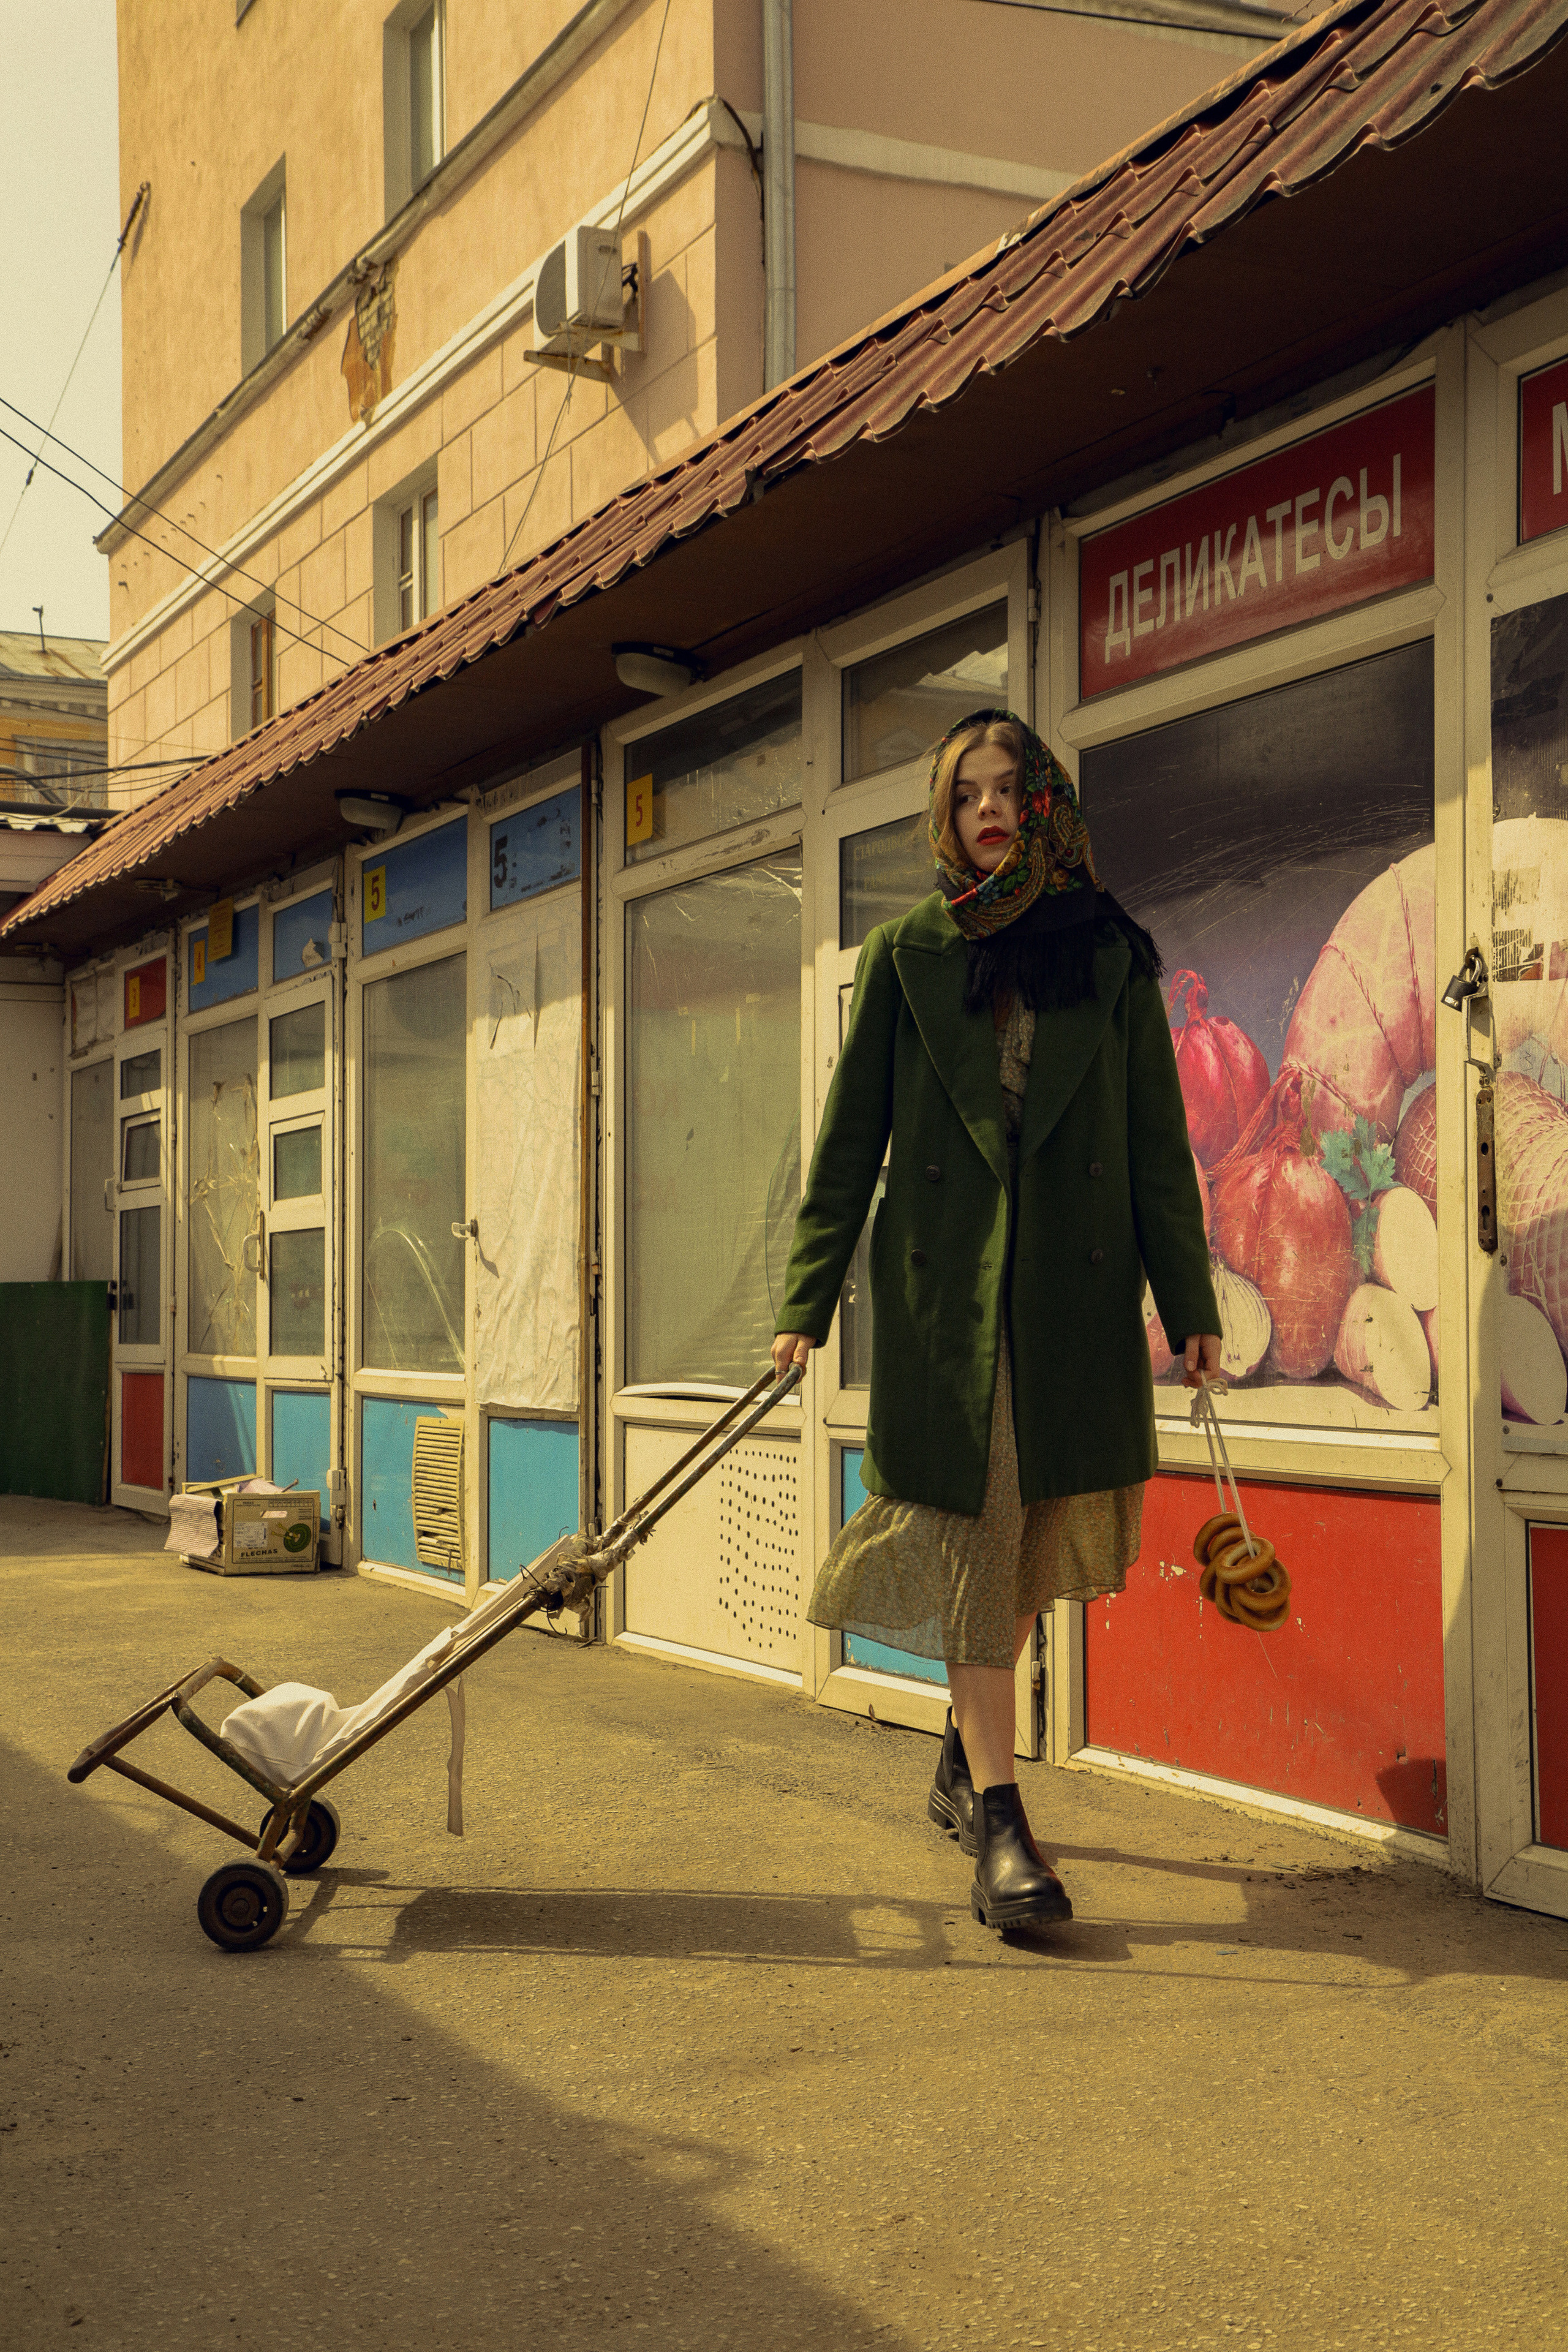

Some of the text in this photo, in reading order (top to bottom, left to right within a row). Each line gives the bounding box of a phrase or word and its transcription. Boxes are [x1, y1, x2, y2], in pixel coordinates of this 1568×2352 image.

[1104, 453, 1402, 664] ДЕЛИКАТЕСЫ
[636, 794, 643, 827] 5
[494, 836, 508, 888] 5
[372, 875, 380, 911] 5
